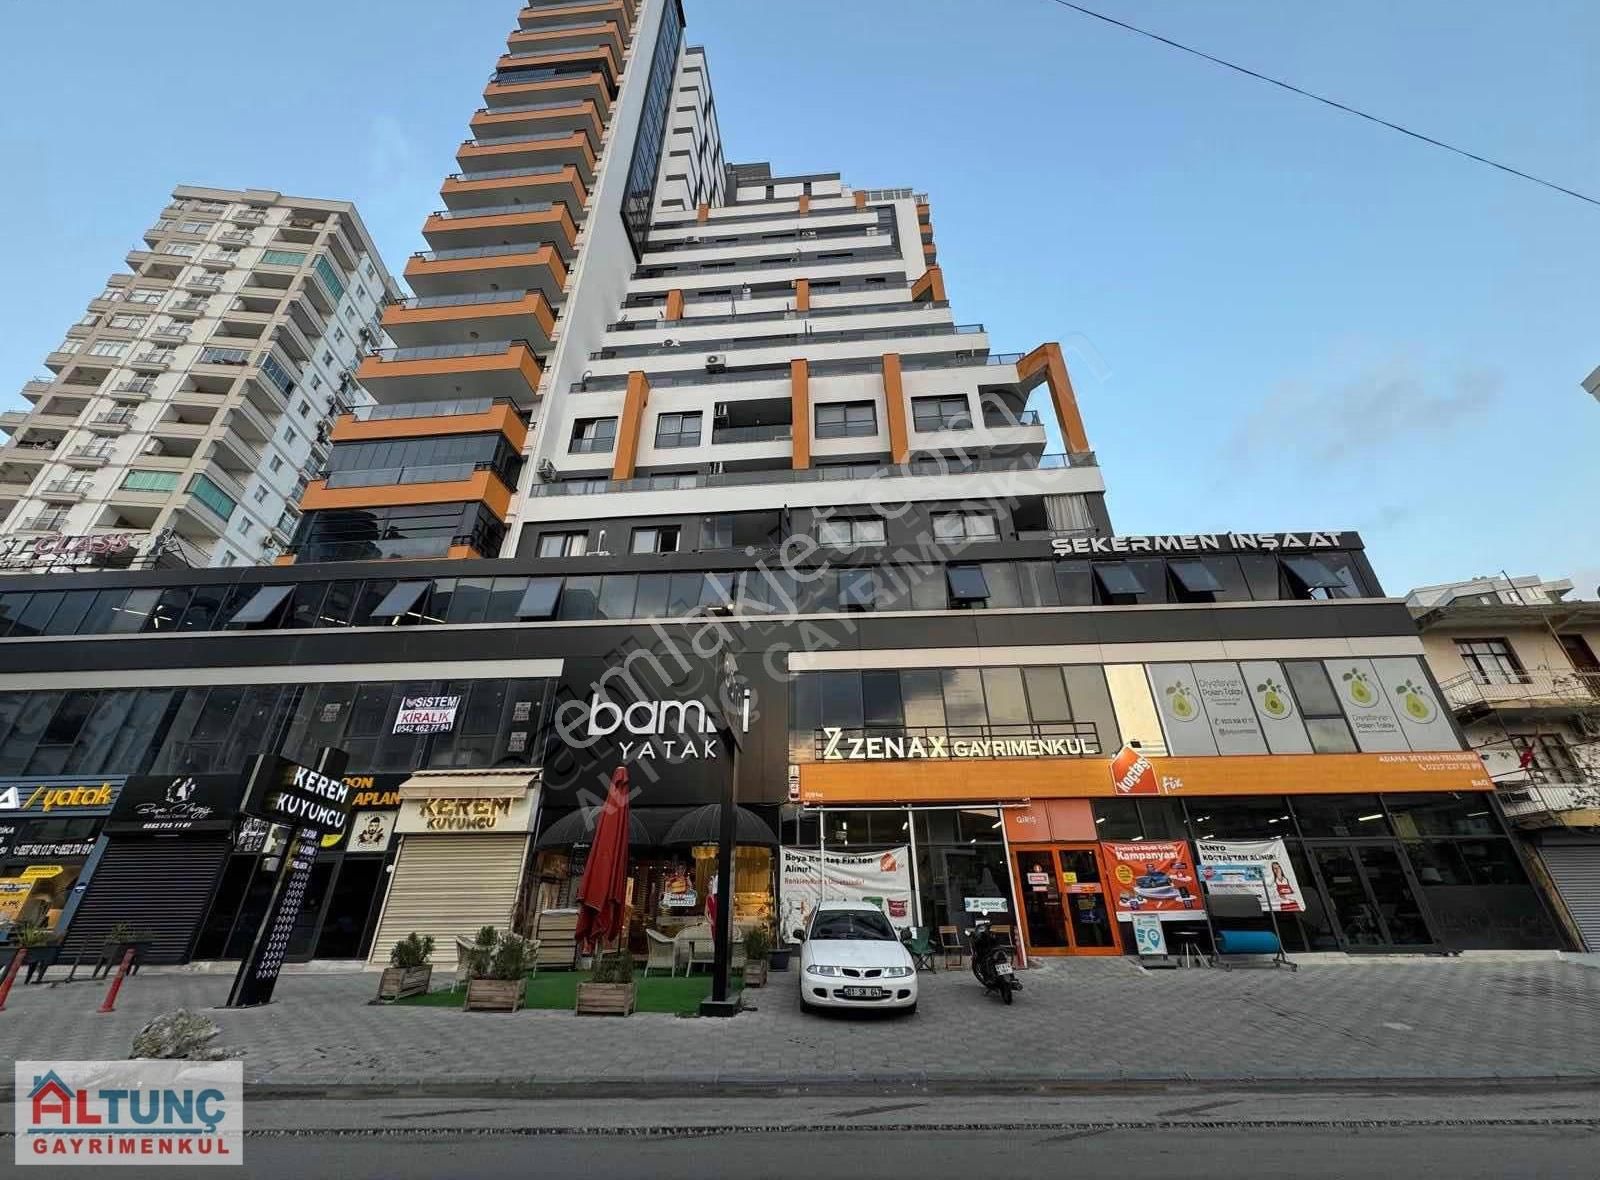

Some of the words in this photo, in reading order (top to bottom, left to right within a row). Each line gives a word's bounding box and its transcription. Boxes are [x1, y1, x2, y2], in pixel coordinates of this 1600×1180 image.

[1052, 534, 1220, 556] ŞEKERMEN
[1228, 531, 1342, 551] İNŞAAT
[401, 711, 450, 723] KİRALIK
[619, 740, 717, 759] YATAK
[848, 736, 947, 760] ZENAX
[293, 766, 349, 803] KEREM
[276, 793, 345, 828] KUYUMCU
[420, 798, 511, 816] KEREM
[427, 817, 495, 829] KUYUMCU
[809, 856, 840, 864] Kotaş
[1116, 852, 1179, 861] Kampanyası
